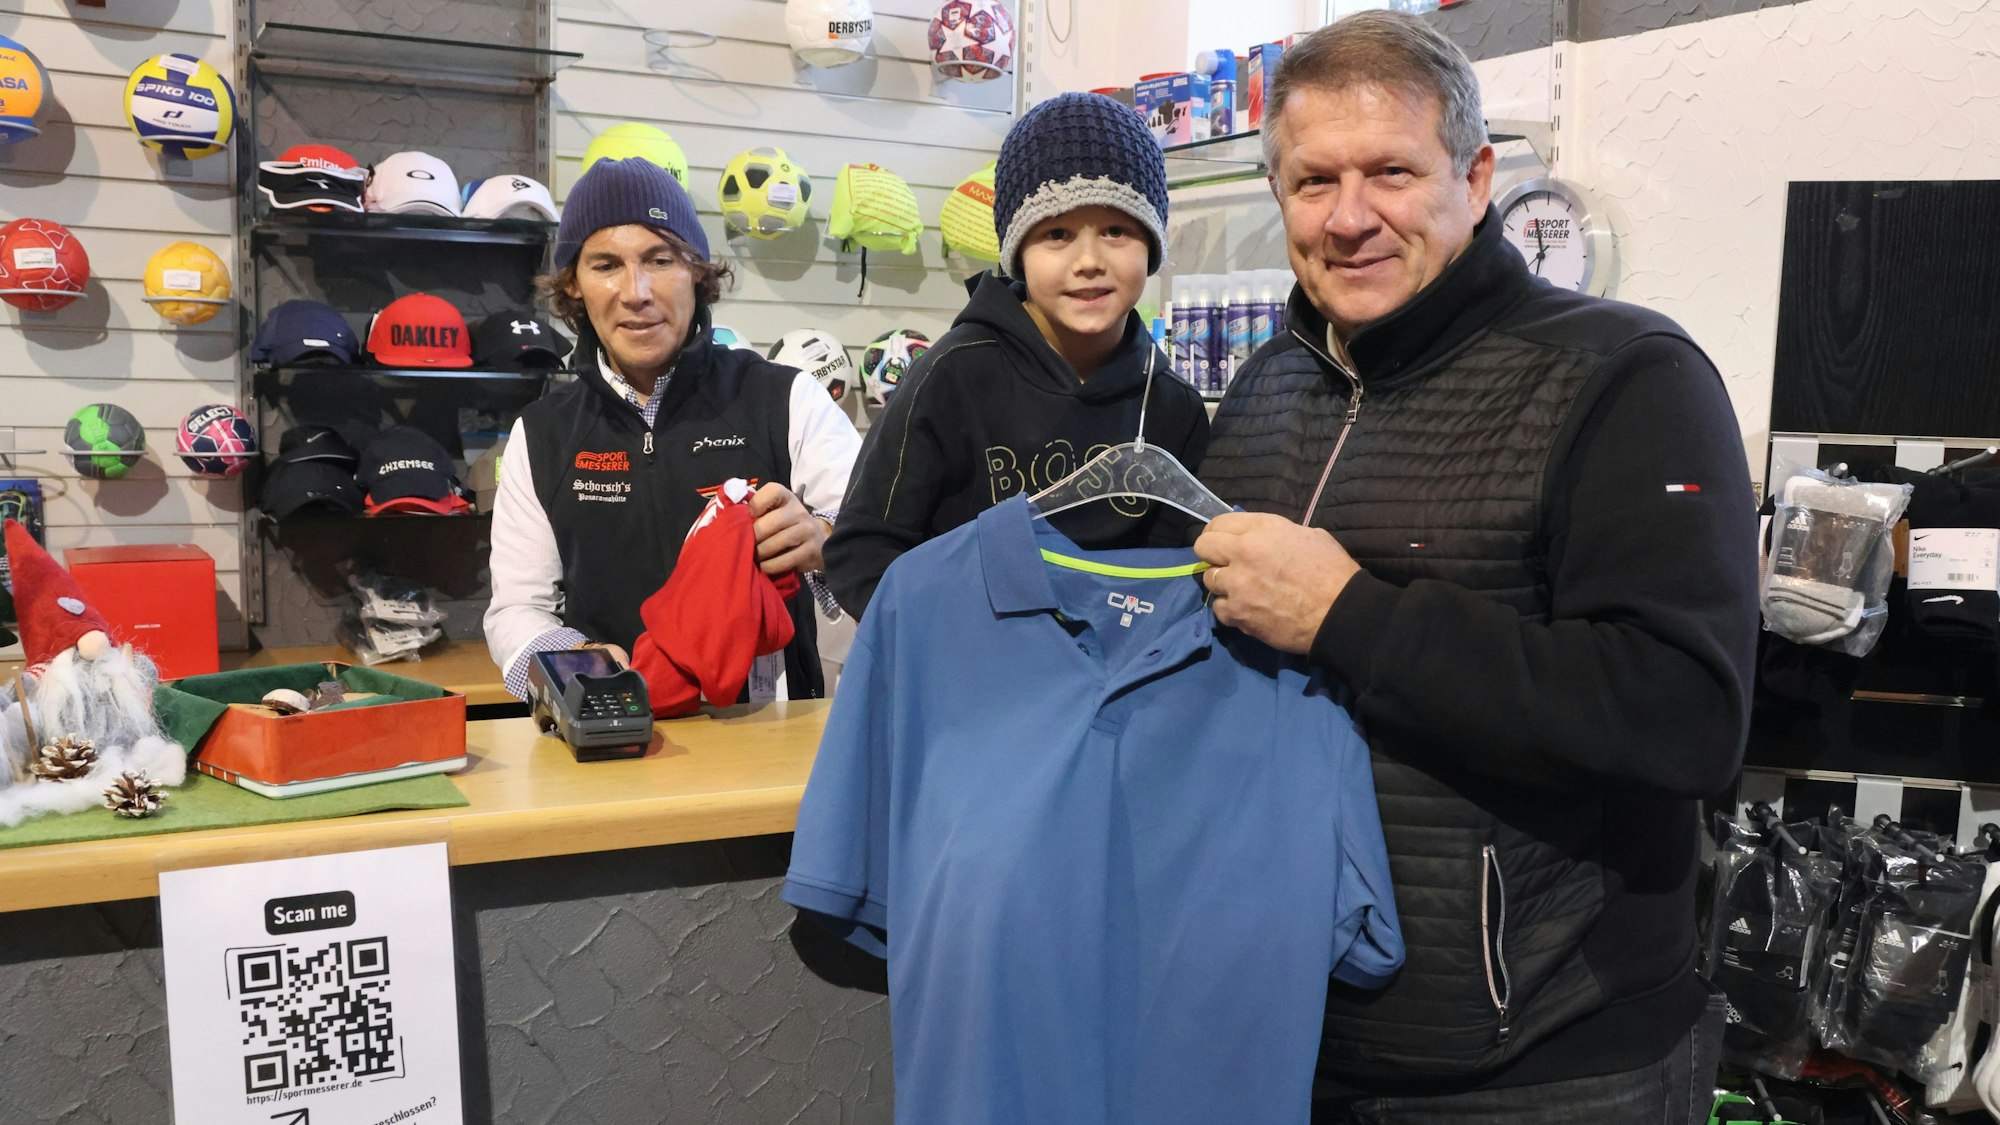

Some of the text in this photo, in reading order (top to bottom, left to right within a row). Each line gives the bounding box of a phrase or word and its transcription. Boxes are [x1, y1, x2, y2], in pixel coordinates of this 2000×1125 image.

[828, 20, 873, 34] DERBYSTA
[136, 83, 216, 107] SPIKO 100
[1540, 219, 1570, 229] SPORT
[390, 324, 459, 348] OAKLEY
[811, 355, 846, 381] ERBYSTAR
[188, 406, 232, 433] SELECT
[692, 434, 746, 453] phenix
[578, 460, 630, 471] MESSERER
[597, 452, 627, 462] SPORT
[378, 459, 435, 475] CHIEMSEE
[1787, 523, 1810, 532] adidas
[1913, 552, 1943, 560] Everyday
[1107, 592, 1155, 614] CMP
[273, 903, 348, 925] Scan me
[1728, 924, 1752, 936] adidas
[1877, 937, 1906, 949] adidas
[246, 1079, 363, 1105] https://sportmesserer.de
[373, 1096, 437, 1125] eschlossen?
